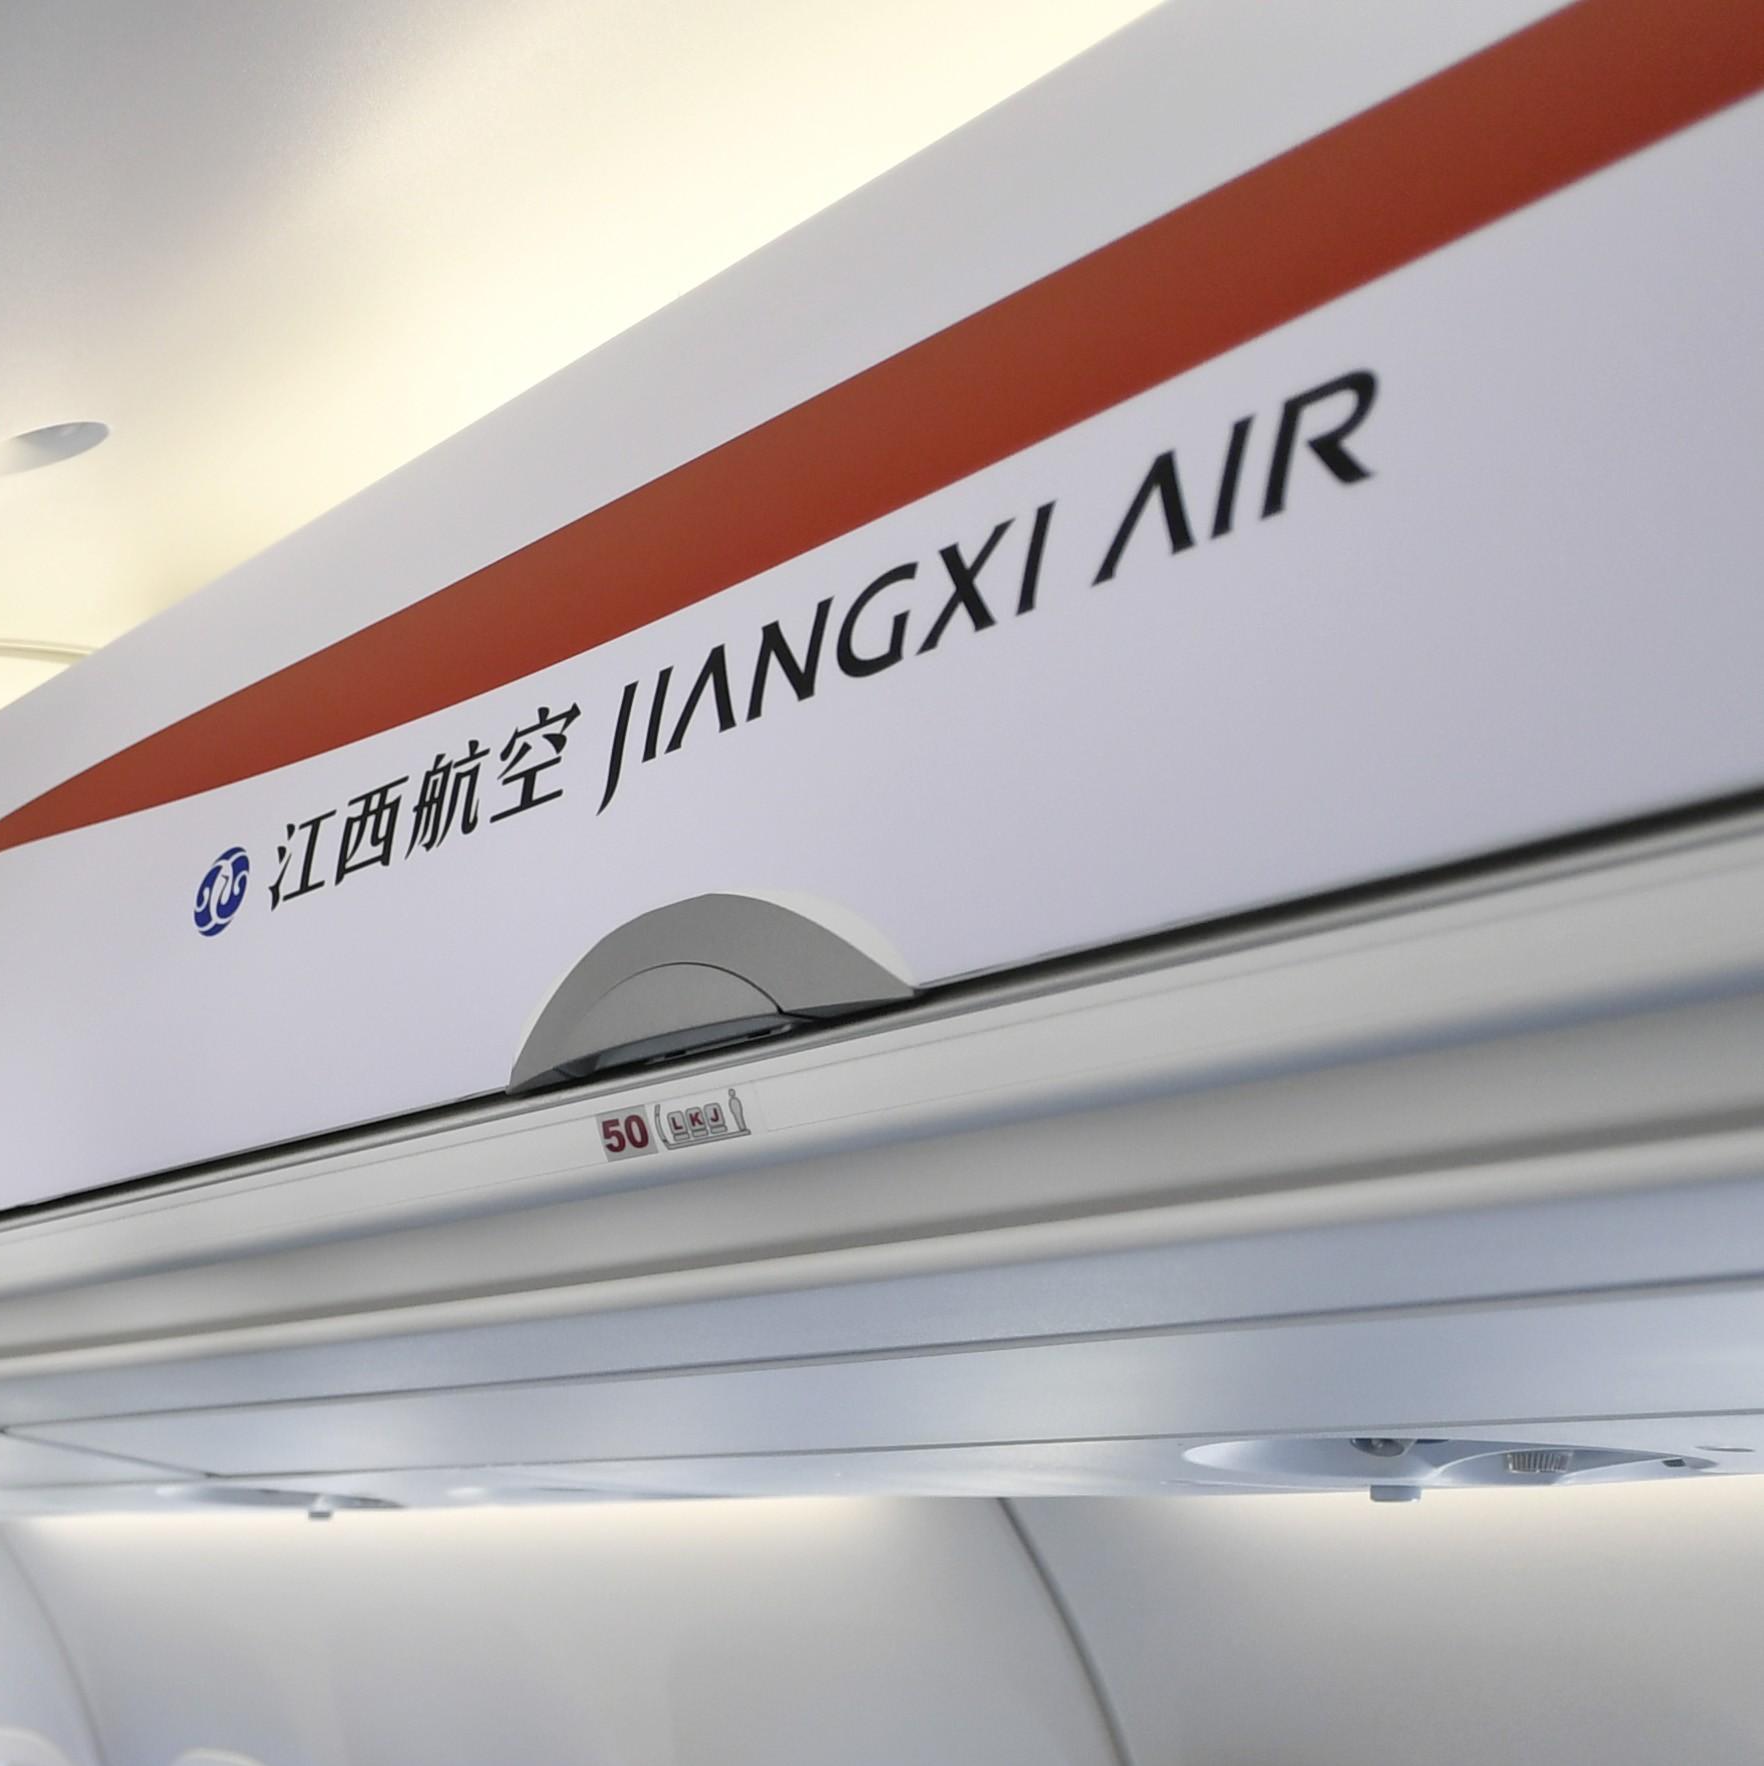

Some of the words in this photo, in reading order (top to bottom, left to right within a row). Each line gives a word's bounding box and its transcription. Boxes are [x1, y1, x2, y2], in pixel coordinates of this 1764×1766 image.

[597, 499, 1058, 816] JIANGXI
[1090, 369, 1382, 590] AIR
[266, 701, 584, 911] 江西航空
[601, 1114, 649, 1153] 50
